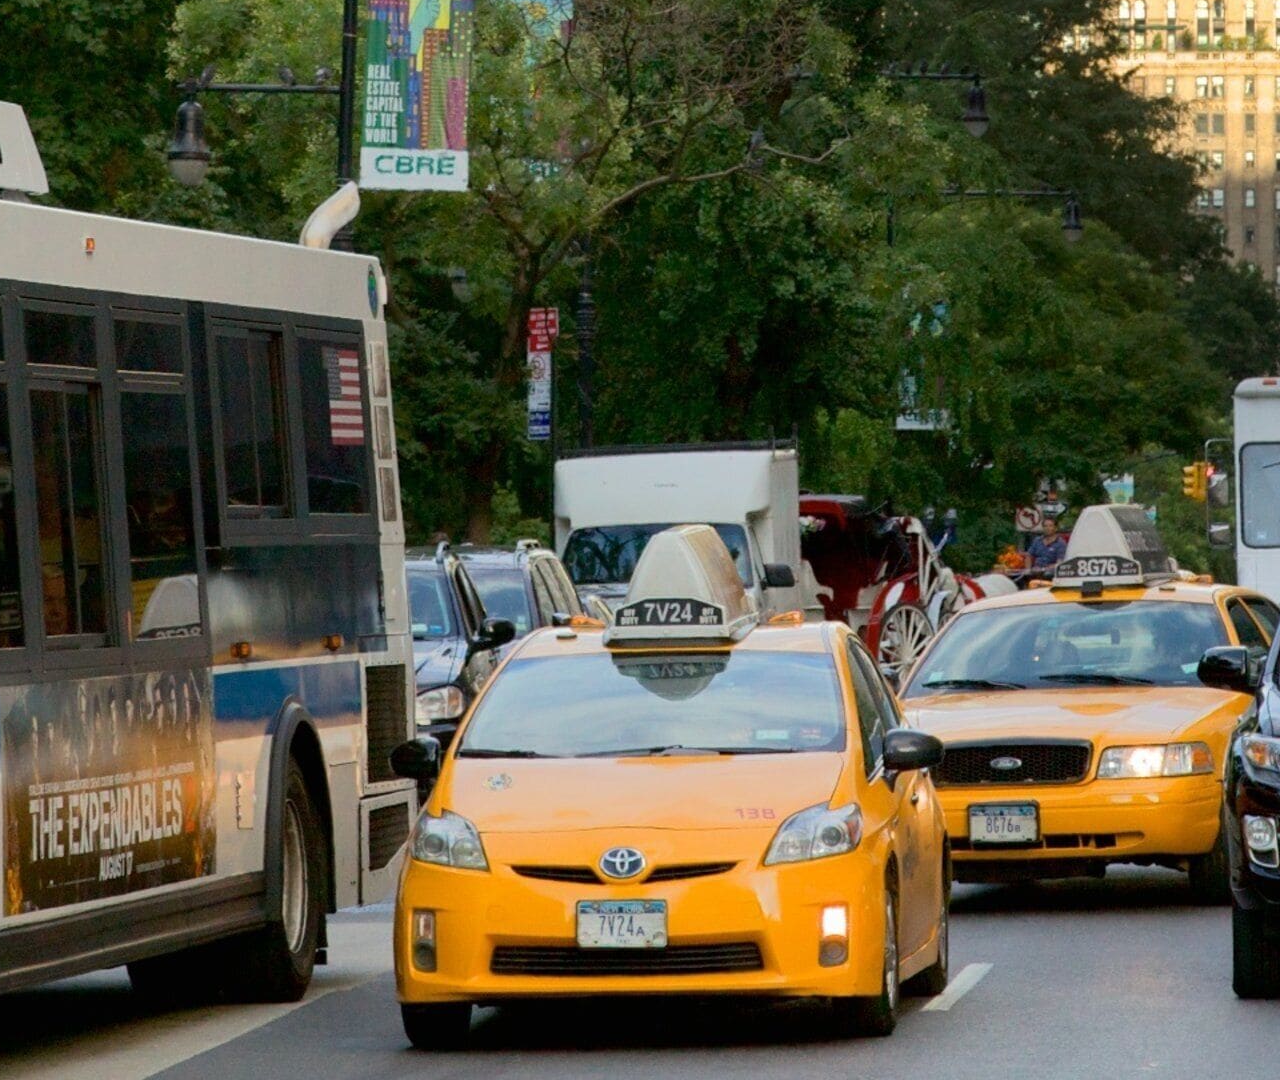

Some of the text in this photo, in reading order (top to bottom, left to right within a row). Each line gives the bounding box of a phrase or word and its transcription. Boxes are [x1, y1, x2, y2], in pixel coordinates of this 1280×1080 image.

[367, 64, 391, 80] REAL
[367, 81, 400, 97] ESTATE
[365, 97, 404, 112] CAPITAL
[365, 113, 398, 128] OF THE
[365, 128, 398, 144] WORLD
[374, 155, 456, 176] CBRE
[1077, 558, 1118, 576] 8G76
[644, 602, 694, 624] 7V24
[28, 796, 65, 862] THE
[67, 777, 184, 856] EXPENDABLES
